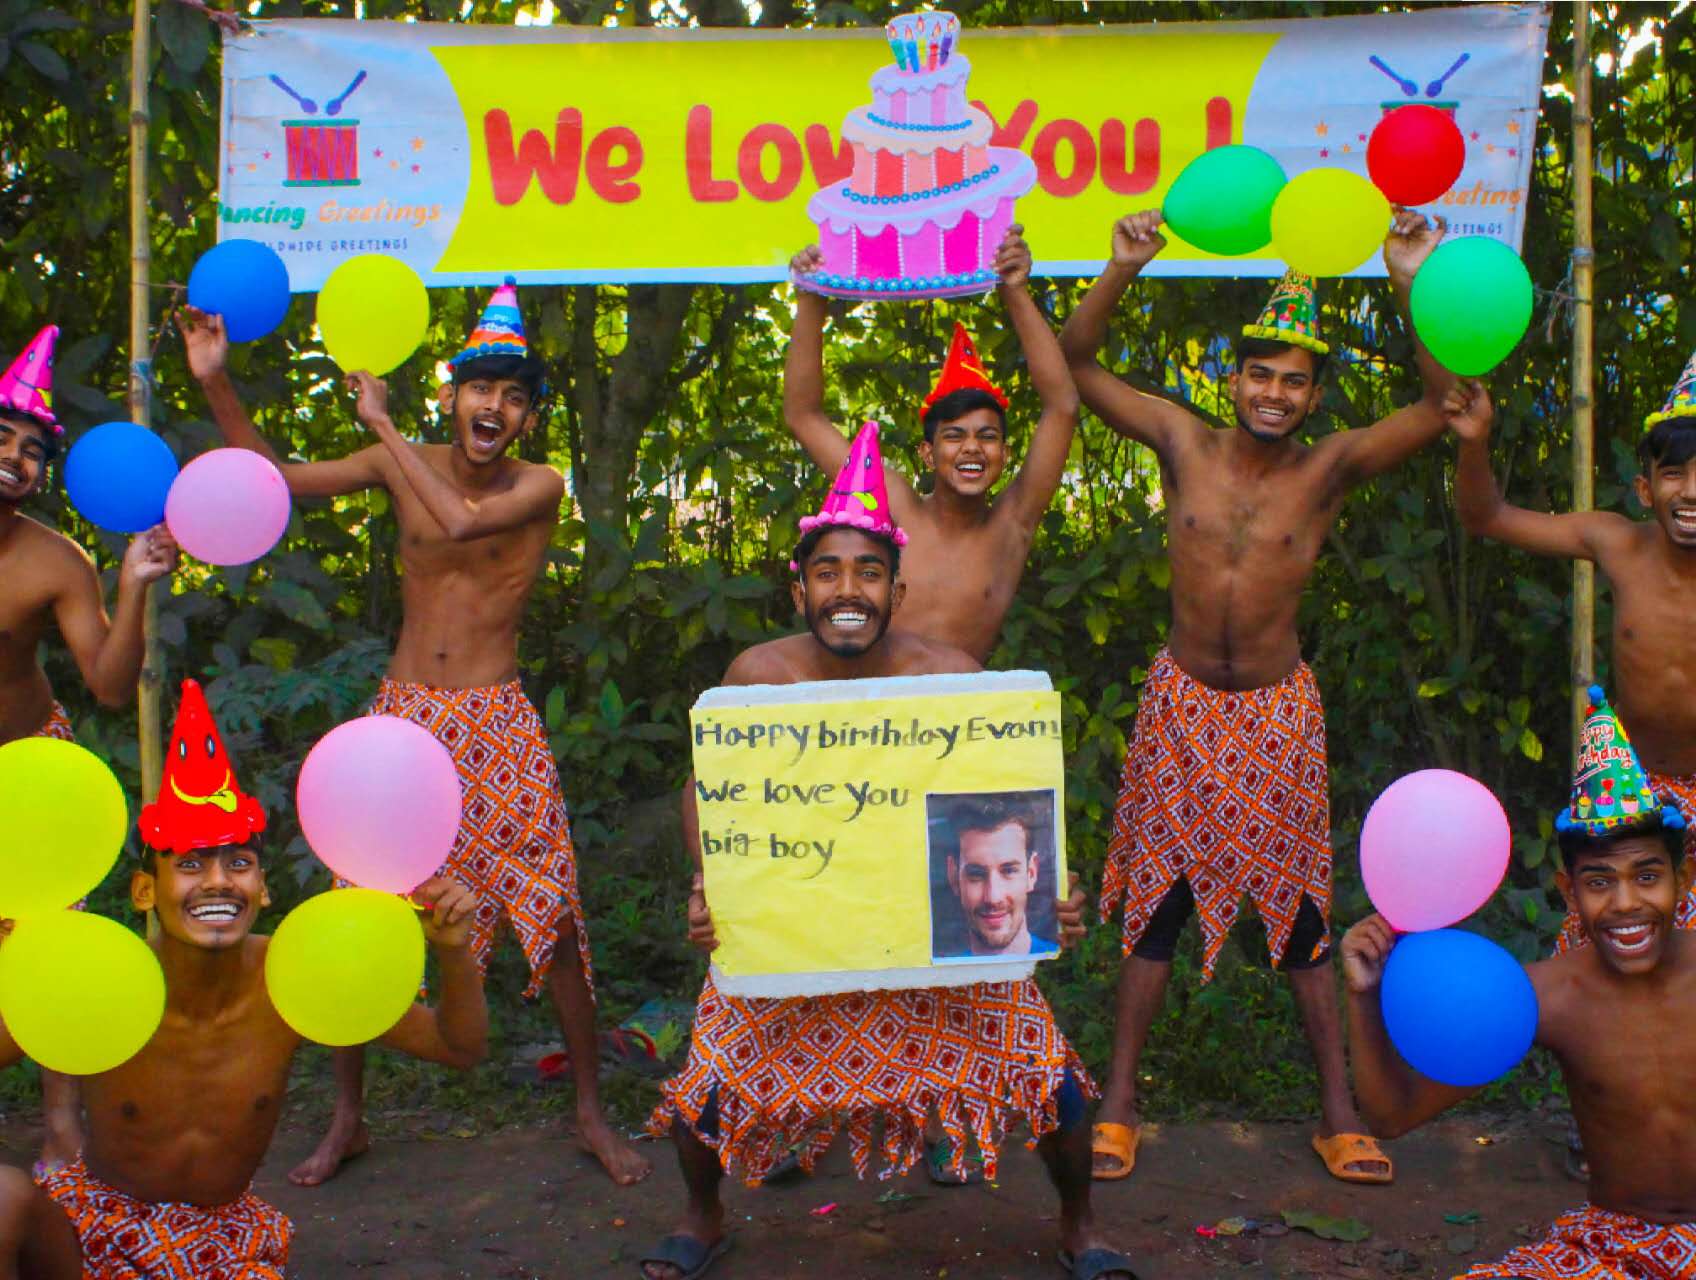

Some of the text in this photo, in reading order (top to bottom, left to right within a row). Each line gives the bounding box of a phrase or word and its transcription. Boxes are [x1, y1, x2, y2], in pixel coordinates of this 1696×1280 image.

[484, 106, 643, 205] We
[686, 104, 855, 203] Lov
[1432, 179, 1522, 213] eeting
[318, 198, 442, 229] Greetings
[1446, 222, 1502, 235] EETINGS
[262, 238, 408, 252] DWIDE GREETINGS
[695, 720, 810, 766] Happy
[818, 718, 961, 761] birthday
[763, 778, 836, 805] love
[769, 832, 836, 881] boy
